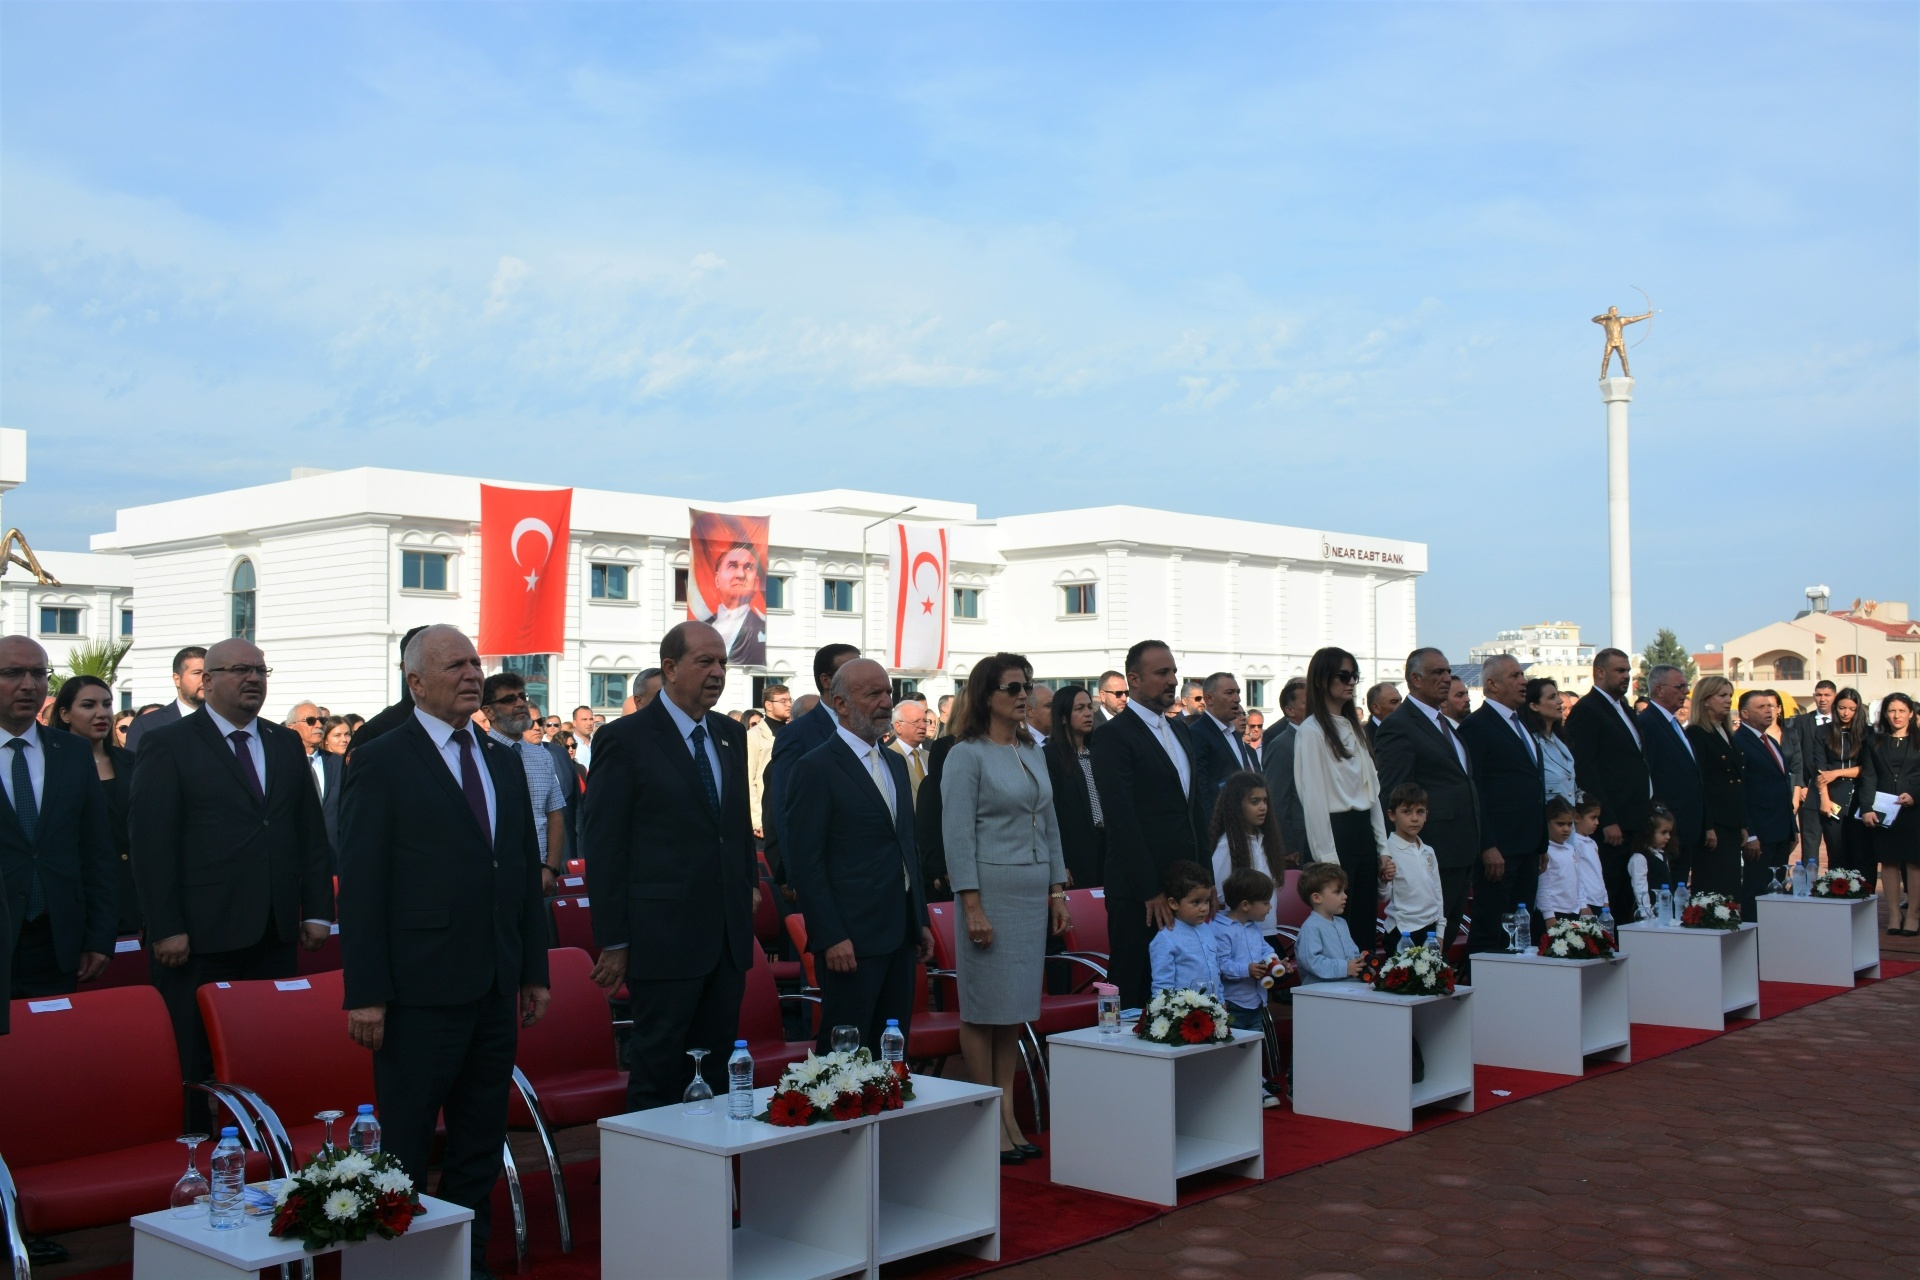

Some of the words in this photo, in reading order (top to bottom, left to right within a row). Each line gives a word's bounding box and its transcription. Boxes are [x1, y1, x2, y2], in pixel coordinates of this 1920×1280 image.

[1331, 546, 1356, 559] NEAR
[1357, 549, 1380, 562] EAST
[1381, 552, 1404, 565] BANK
